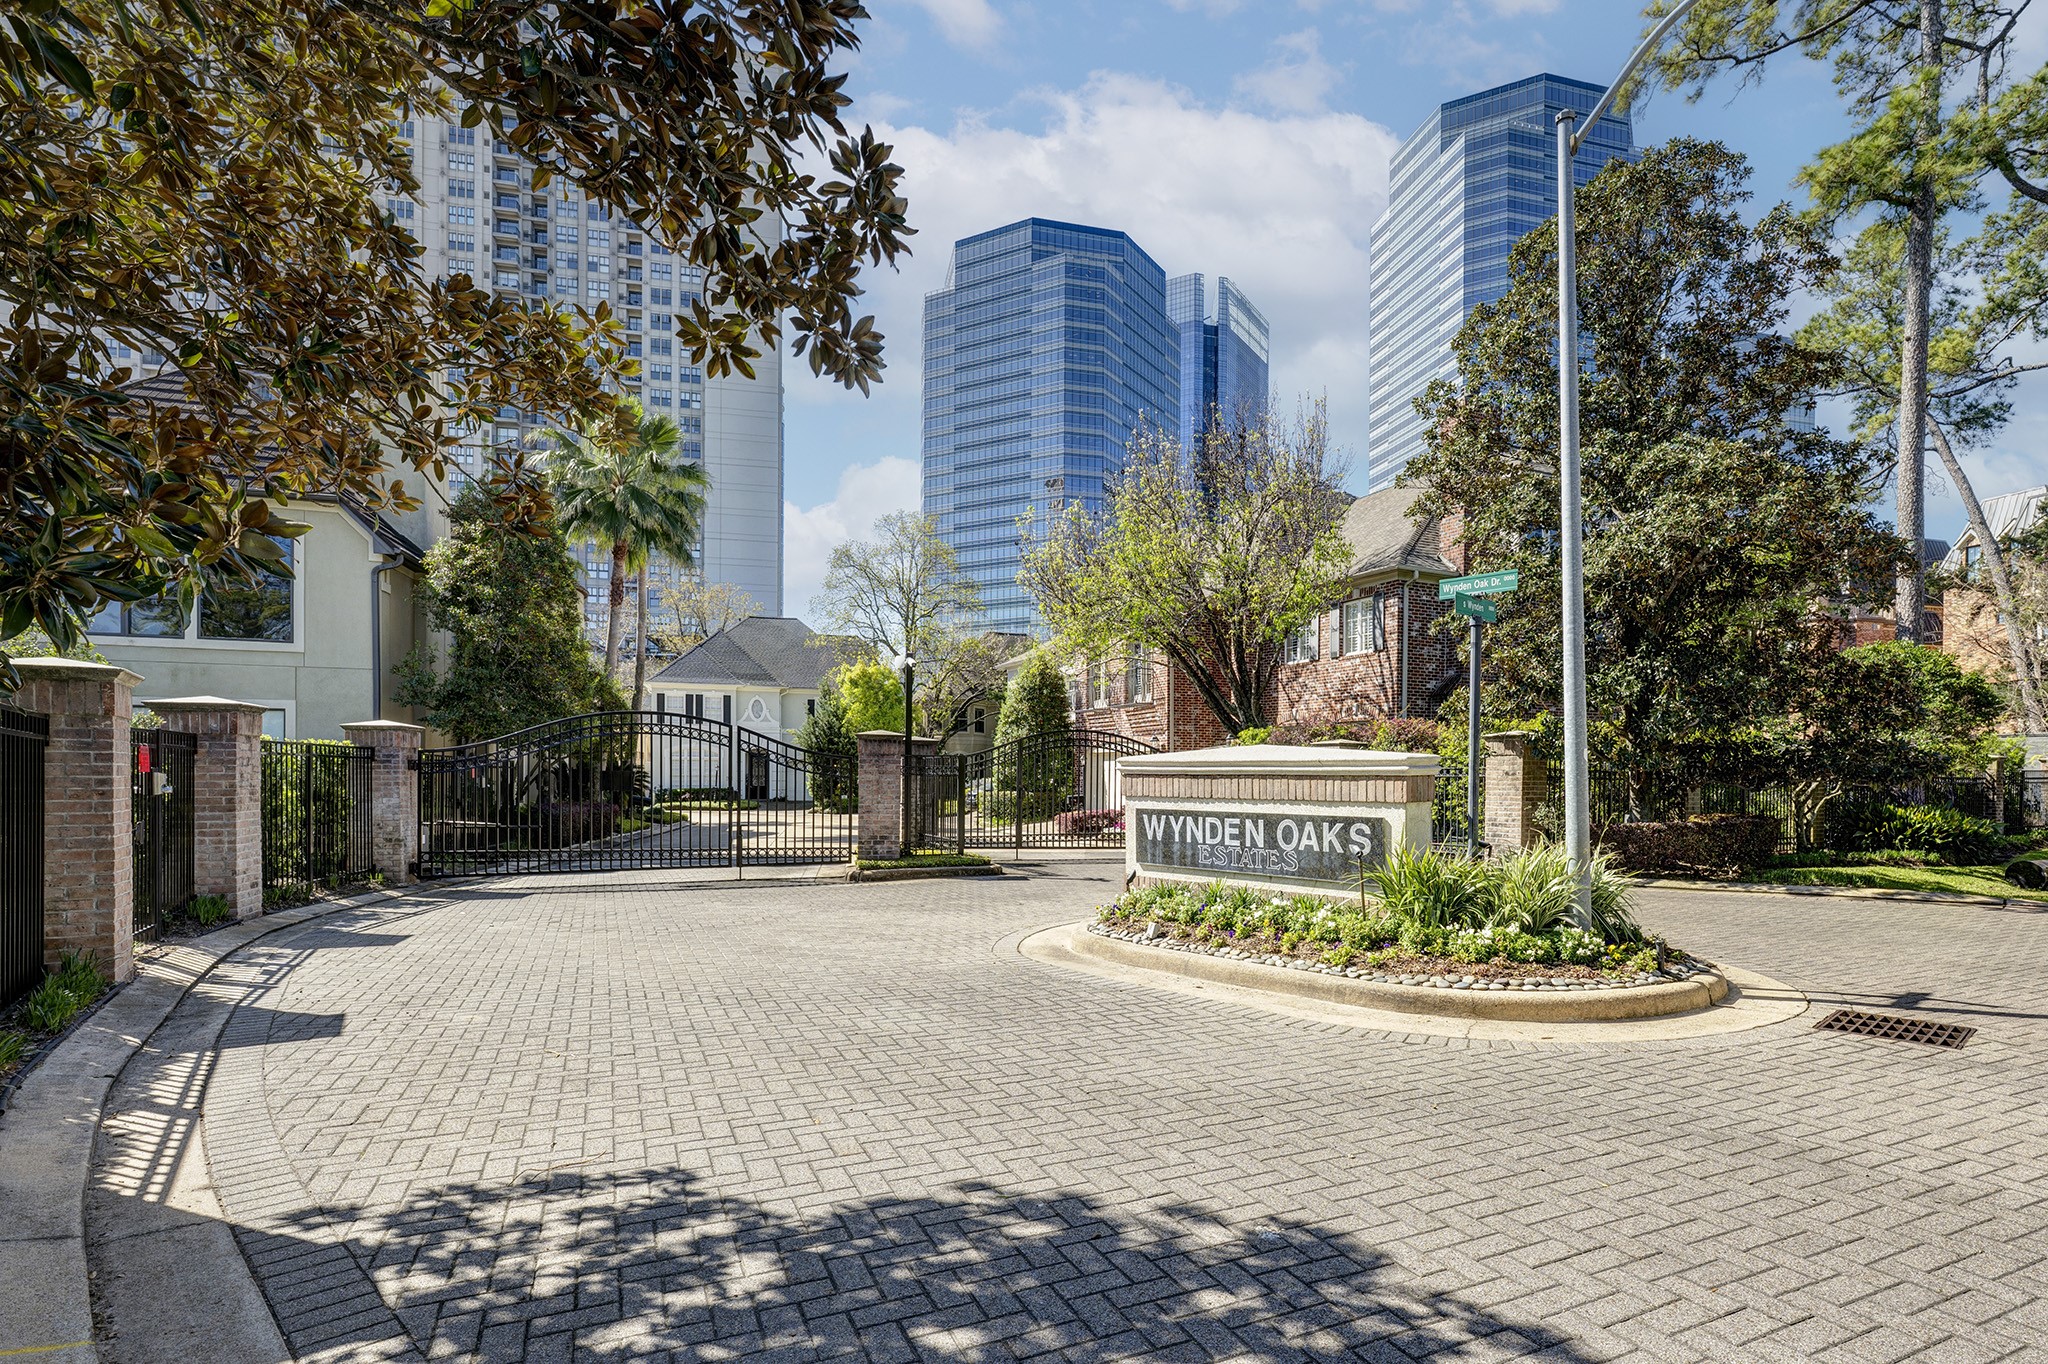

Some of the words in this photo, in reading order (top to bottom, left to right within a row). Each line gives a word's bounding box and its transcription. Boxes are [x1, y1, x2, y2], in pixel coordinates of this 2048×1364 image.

[1443, 583, 1472, 594] Wynden
[1474, 580, 1488, 588] Oak
[1491, 578, 1501, 586] Dr.
[1142, 813, 1265, 848] WYNDEN
[1276, 818, 1372, 856] OAKS
[1197, 844, 1299, 871] ESTATES
